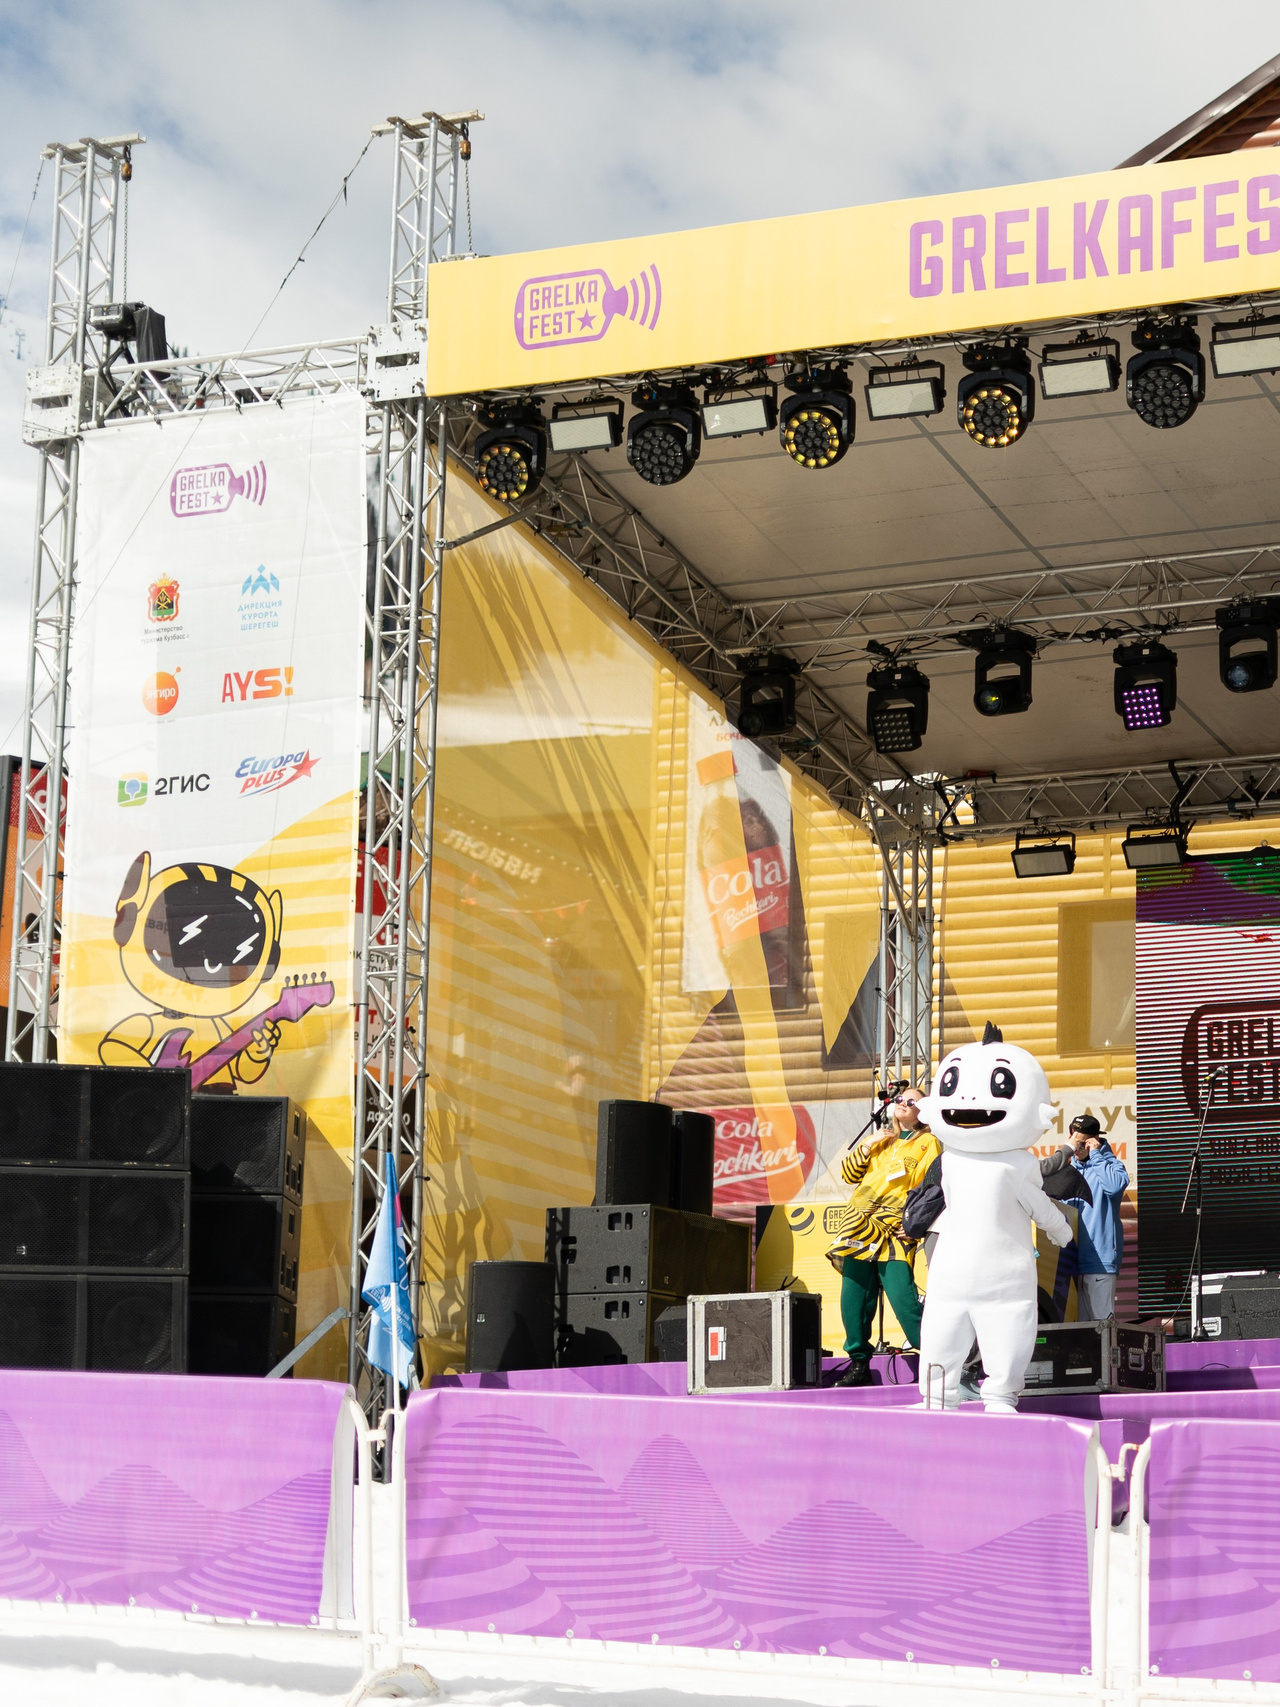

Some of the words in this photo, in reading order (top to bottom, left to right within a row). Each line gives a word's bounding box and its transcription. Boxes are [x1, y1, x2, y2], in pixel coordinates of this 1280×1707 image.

[530, 280, 598, 311] GRELKA
[529, 310, 575, 339] FEST
[180, 471, 225, 491] GRELKA
[180, 491, 210, 510] FEST
[237, 599, 283, 612] ДИРЕКЦИЯ
[241, 610, 278, 621] КУРОРТА
[240, 620, 280, 631] ШЕРЕГЕШ
[221, 666, 295, 703] AYS!
[154, 773, 211, 796] 2ГИС
[707, 857, 782, 905] Cola
[716, 1115, 774, 1139] Cola
[714, 1140, 798, 1177] ochkari
